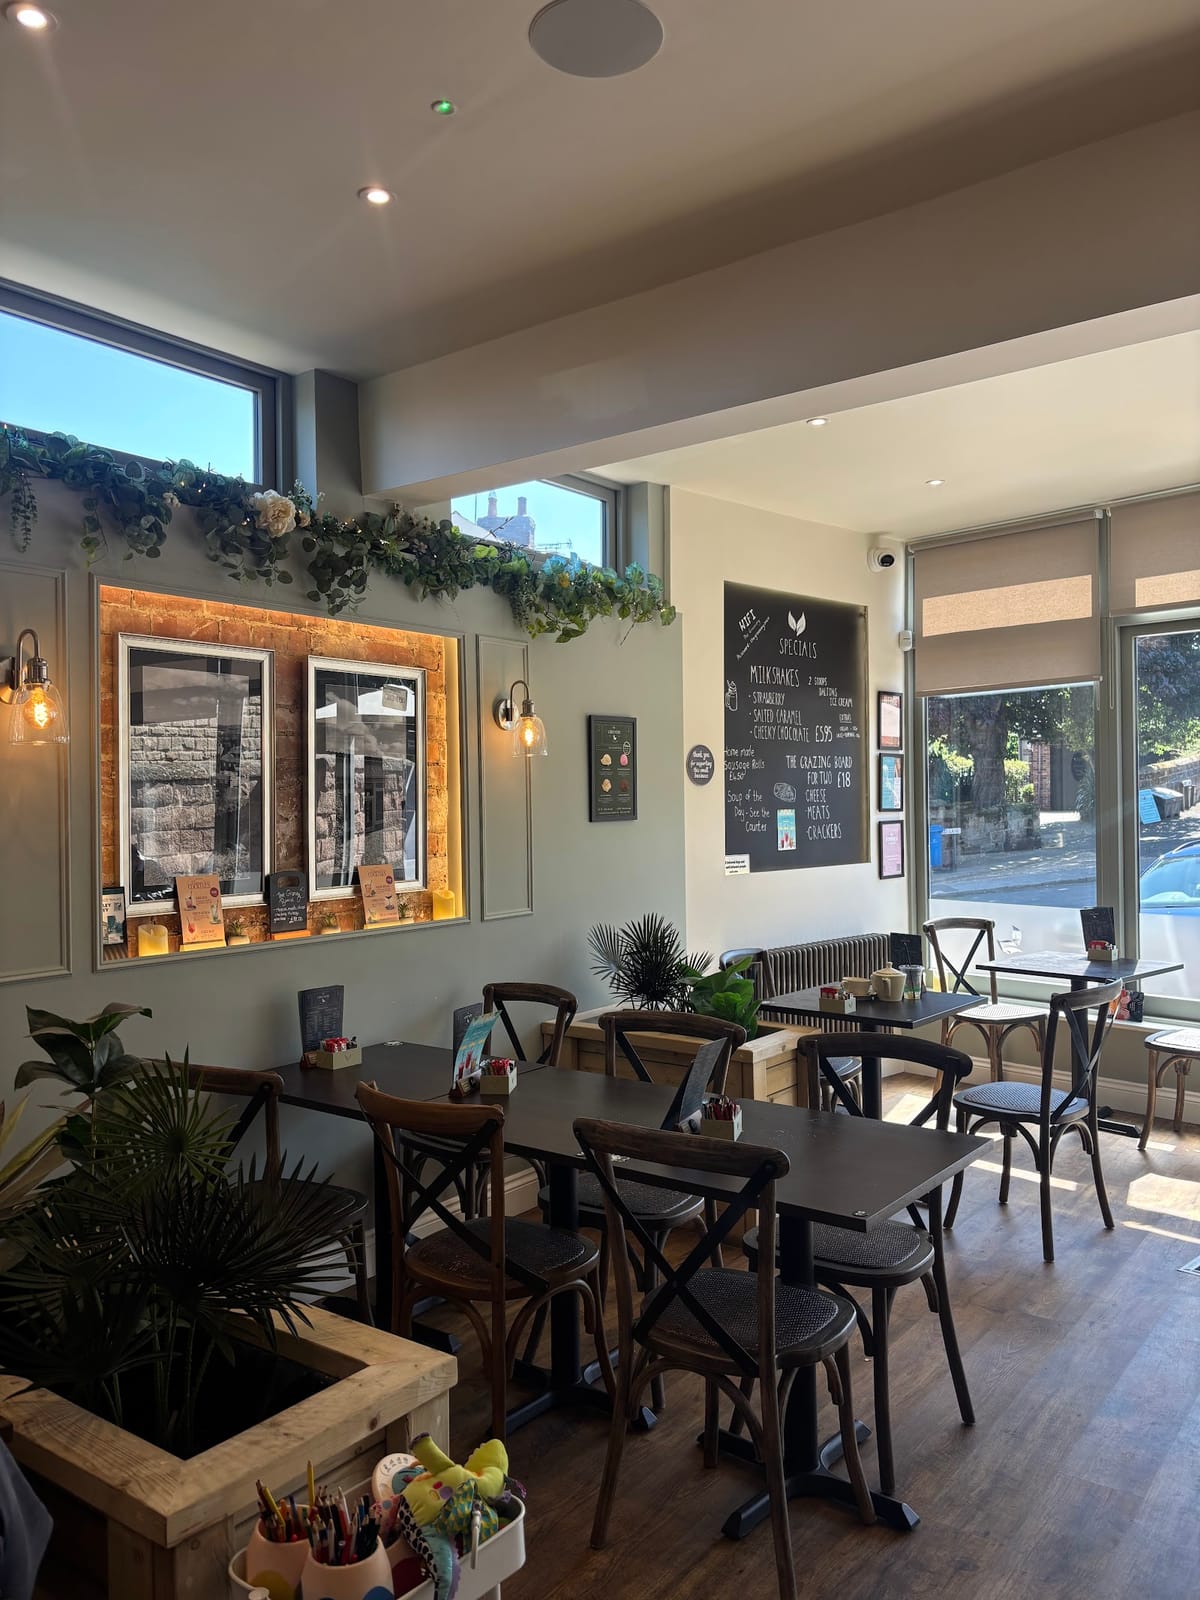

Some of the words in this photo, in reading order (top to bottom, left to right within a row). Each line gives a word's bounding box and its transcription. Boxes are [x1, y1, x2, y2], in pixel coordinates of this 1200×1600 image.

[779, 638, 817, 659] SPECIALS
[750, 665, 800, 688] MILKSHAKES
[808, 676, 812, 686] 2
[752, 691, 785, 706] STRAWBERRY
[753, 708, 774, 723] SALTED
[776, 709, 802, 726] CARAMEL
[753, 725, 776, 740] CHEEKY
[777, 726, 810, 743] CHOCOLATE
[786, 754, 797, 769] THE
[800, 755, 832, 769] GRAZING
[834, 755, 853, 769] BOARD
[807, 771, 818, 785] FOR
[819, 771, 833, 785] TWO
[837, 771, 851, 788] £18
[727, 790, 743, 806] Soup
[745, 788, 752, 801] of
[753, 789, 763, 802] the
[805, 788, 827, 803] CHEESE
[734, 805, 745, 822] Day
[749, 807, 760, 818] See
[761, 806, 770, 818] the
[745, 820, 767, 832] Counter
